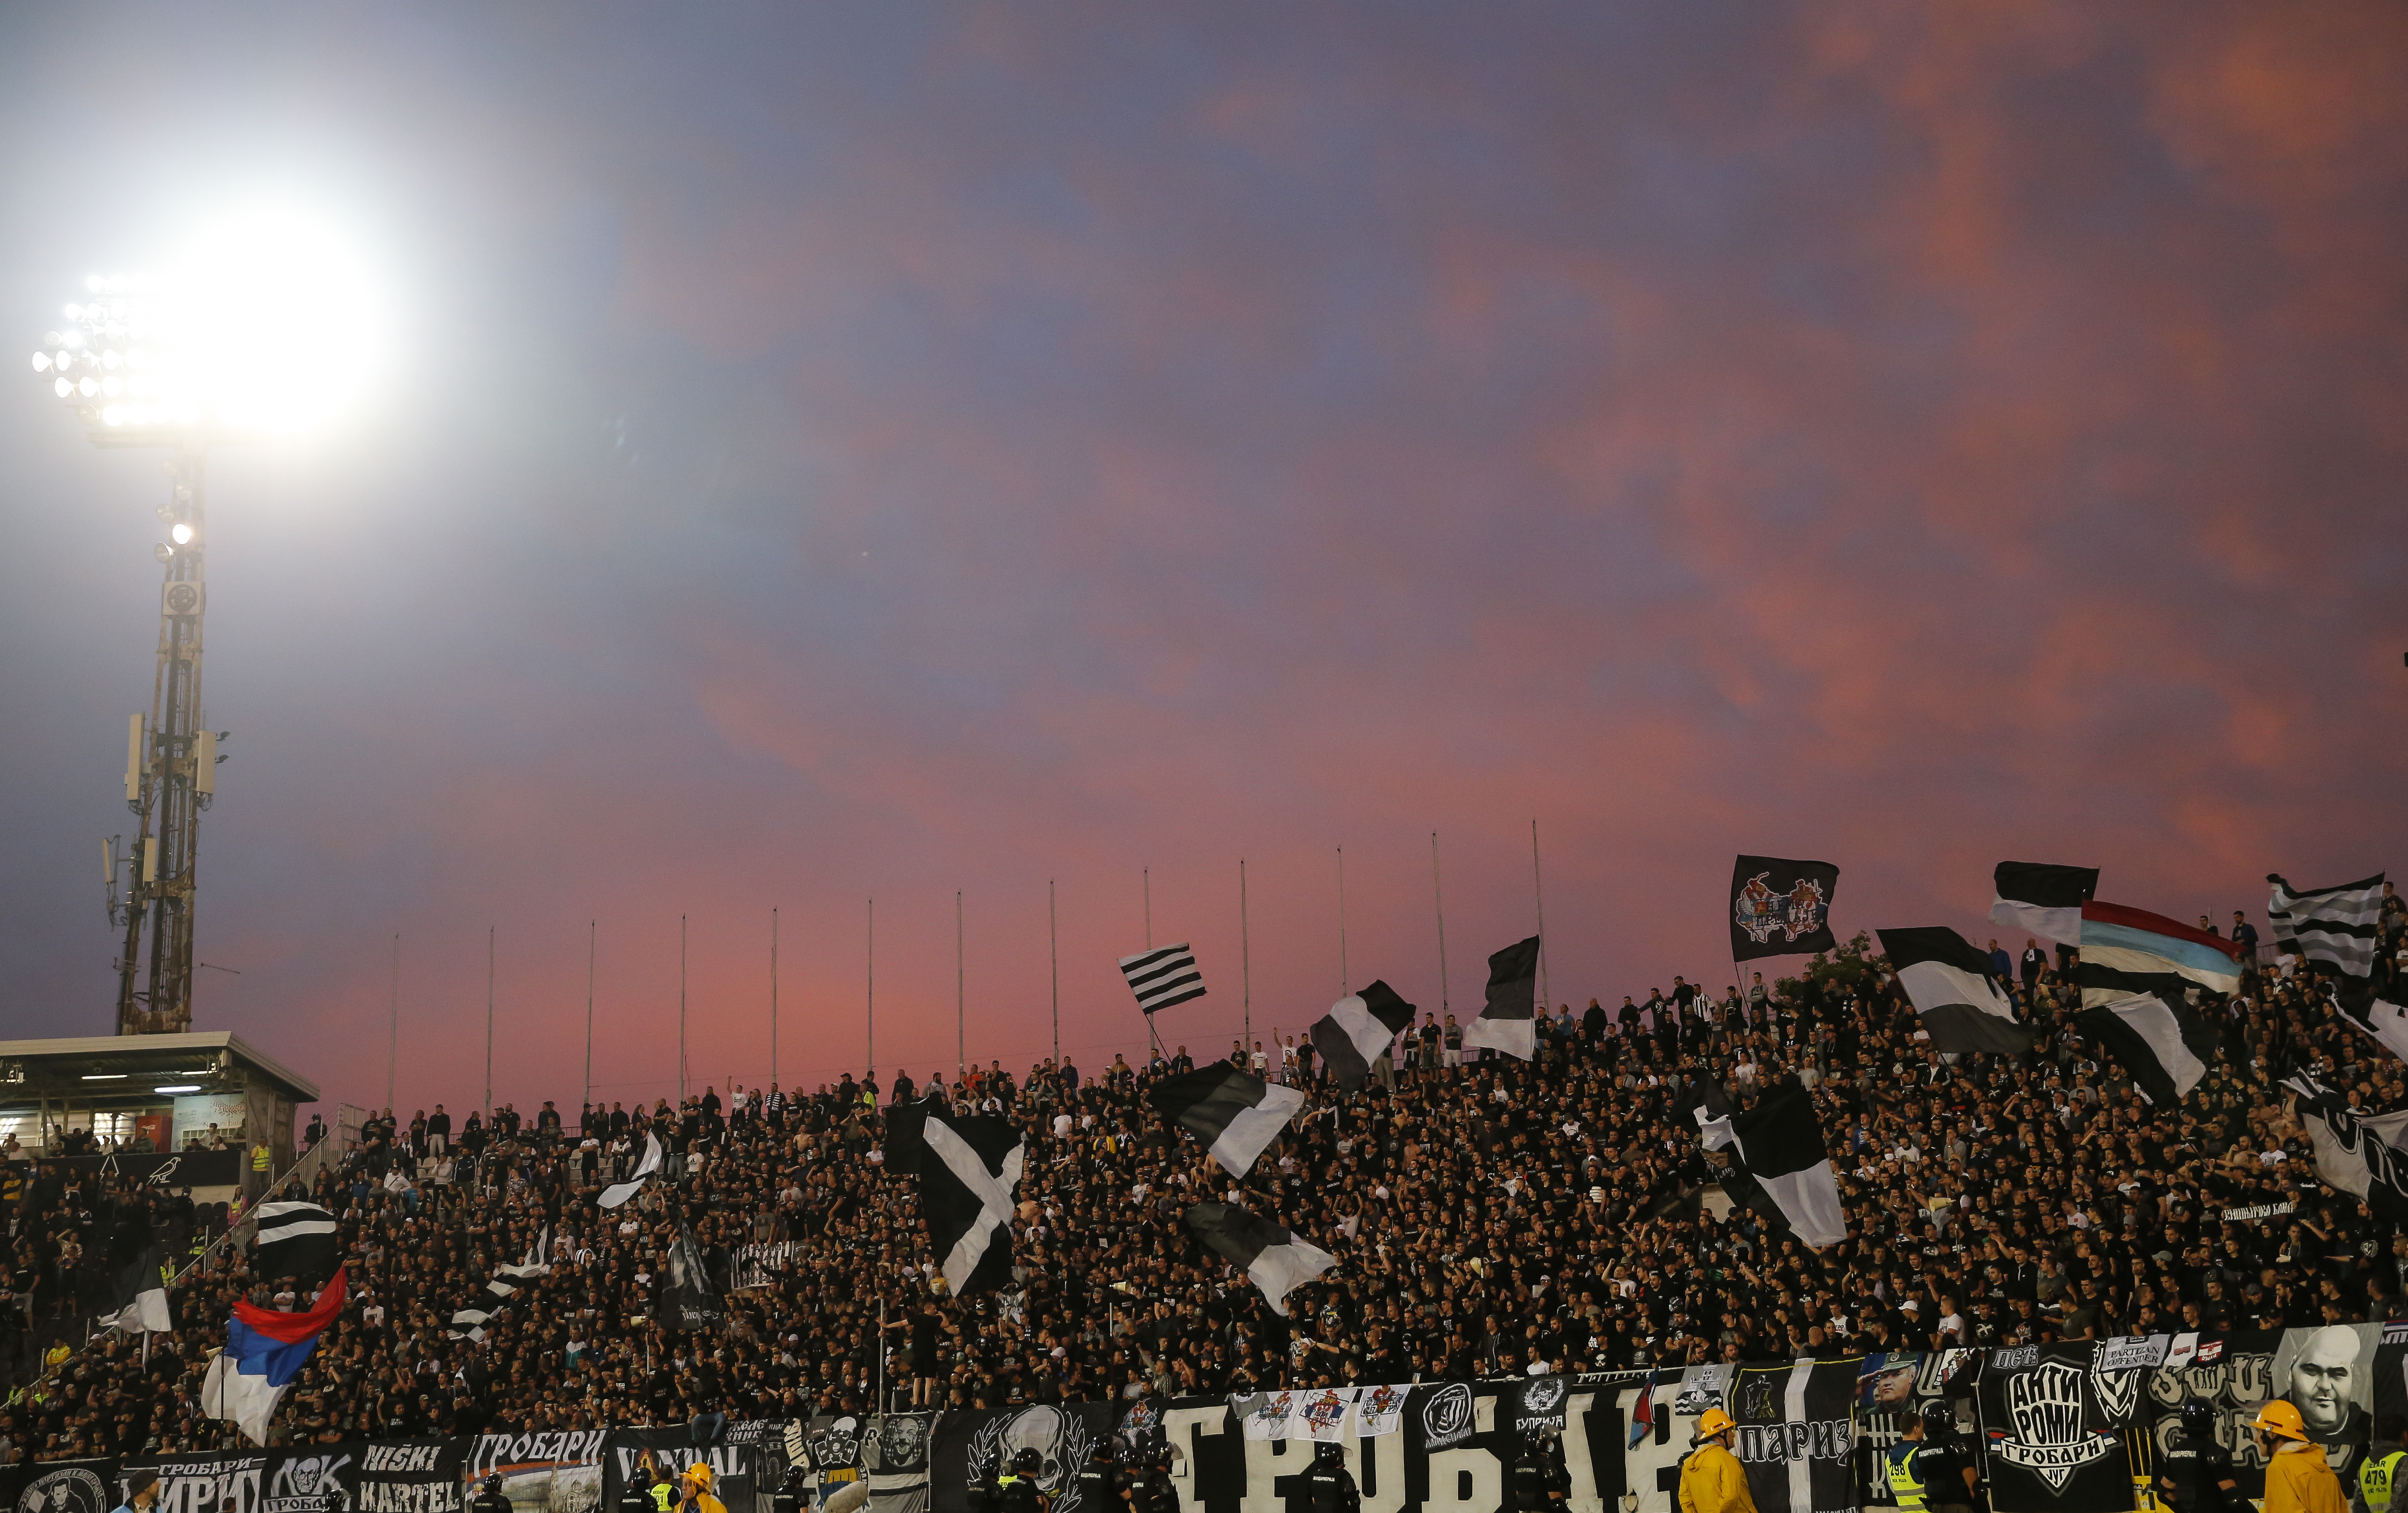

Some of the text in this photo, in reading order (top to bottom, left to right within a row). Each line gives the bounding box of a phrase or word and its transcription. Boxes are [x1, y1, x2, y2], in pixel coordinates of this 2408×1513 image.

[2107, 1354, 2159, 1366] OFFENDER
[2111, 1346, 2160, 1358] PARTIZAN
[2014, 1364, 2080, 1408] АНТИ
[2150, 1356, 2269, 1404] SOU
[2015, 1402, 2080, 1445] РОМИ
[474, 1430, 607, 1478] ГРОБАРИ
[2005, 1438, 2101, 1464] ГРОБАРИ
[158, 1457, 252, 1476] ГРОБАРИ
[1889, 1463, 1906, 1476] 298
[2364, 1469, 2387, 1485] 479
[359, 1481, 460, 1513] KARTEL
